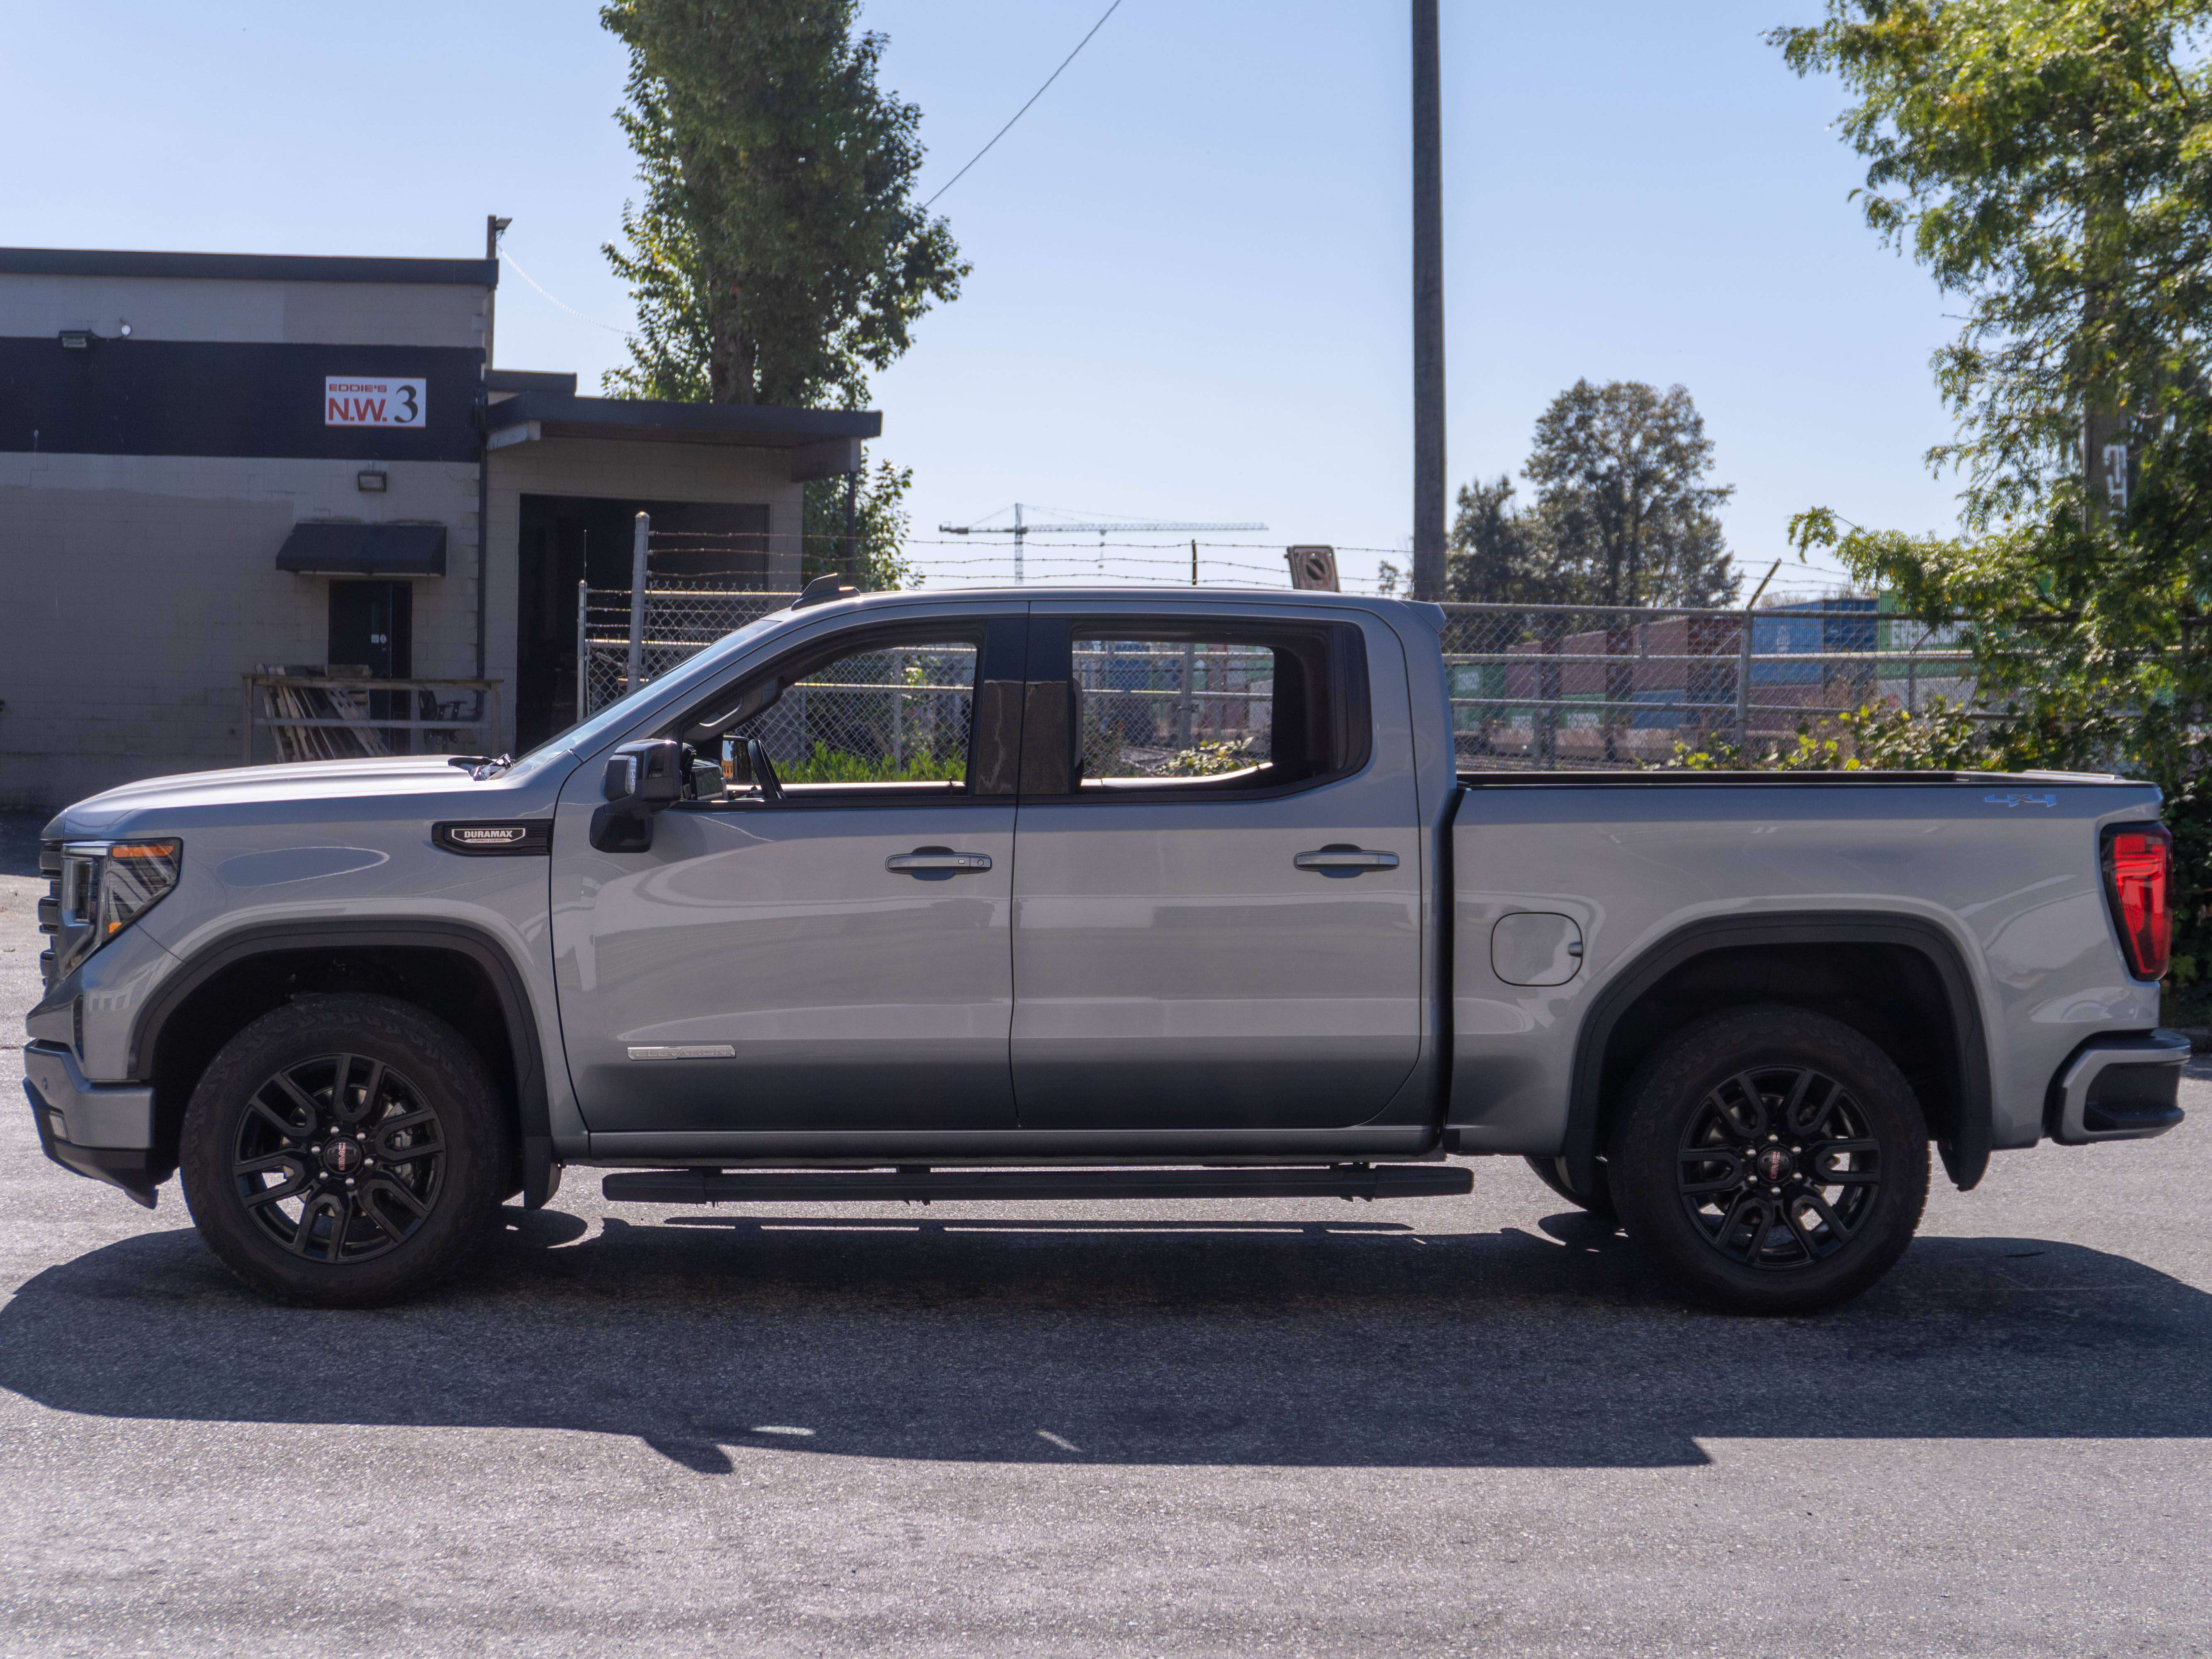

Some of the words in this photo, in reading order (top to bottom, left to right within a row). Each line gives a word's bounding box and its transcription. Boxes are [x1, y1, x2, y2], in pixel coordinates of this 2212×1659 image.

[329, 384, 387, 392] EDDIE'S
[329, 398, 387, 422] N.W.
[394, 385, 418, 423] 3
[636, 1048, 727, 1057] ELEVATION
[1770, 1151, 1780, 1179] GMC
